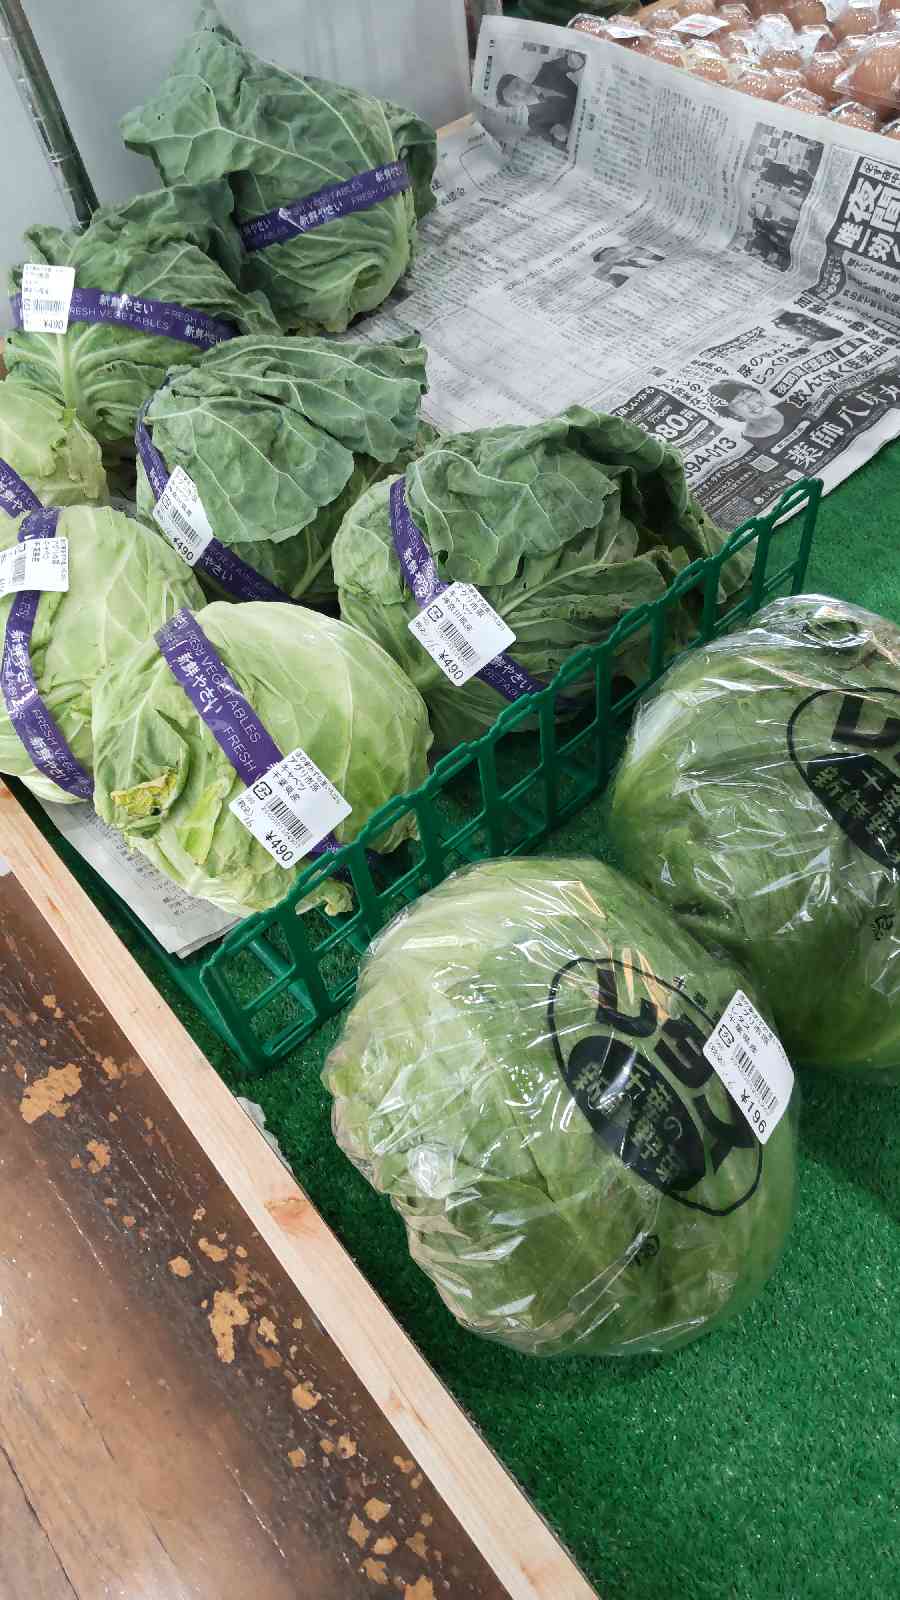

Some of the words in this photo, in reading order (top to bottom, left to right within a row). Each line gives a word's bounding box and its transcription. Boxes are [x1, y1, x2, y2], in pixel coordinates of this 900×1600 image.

[175, 651, 225, 713] 新鮮やさい
[437, 649, 464, 681] ¥490
[203, 656, 262, 743] VEGETABLES
[222, 725, 257, 772] FRESH
[262, 829, 295, 863] ¥490
[738, 1088, 768, 1133] ¥196
